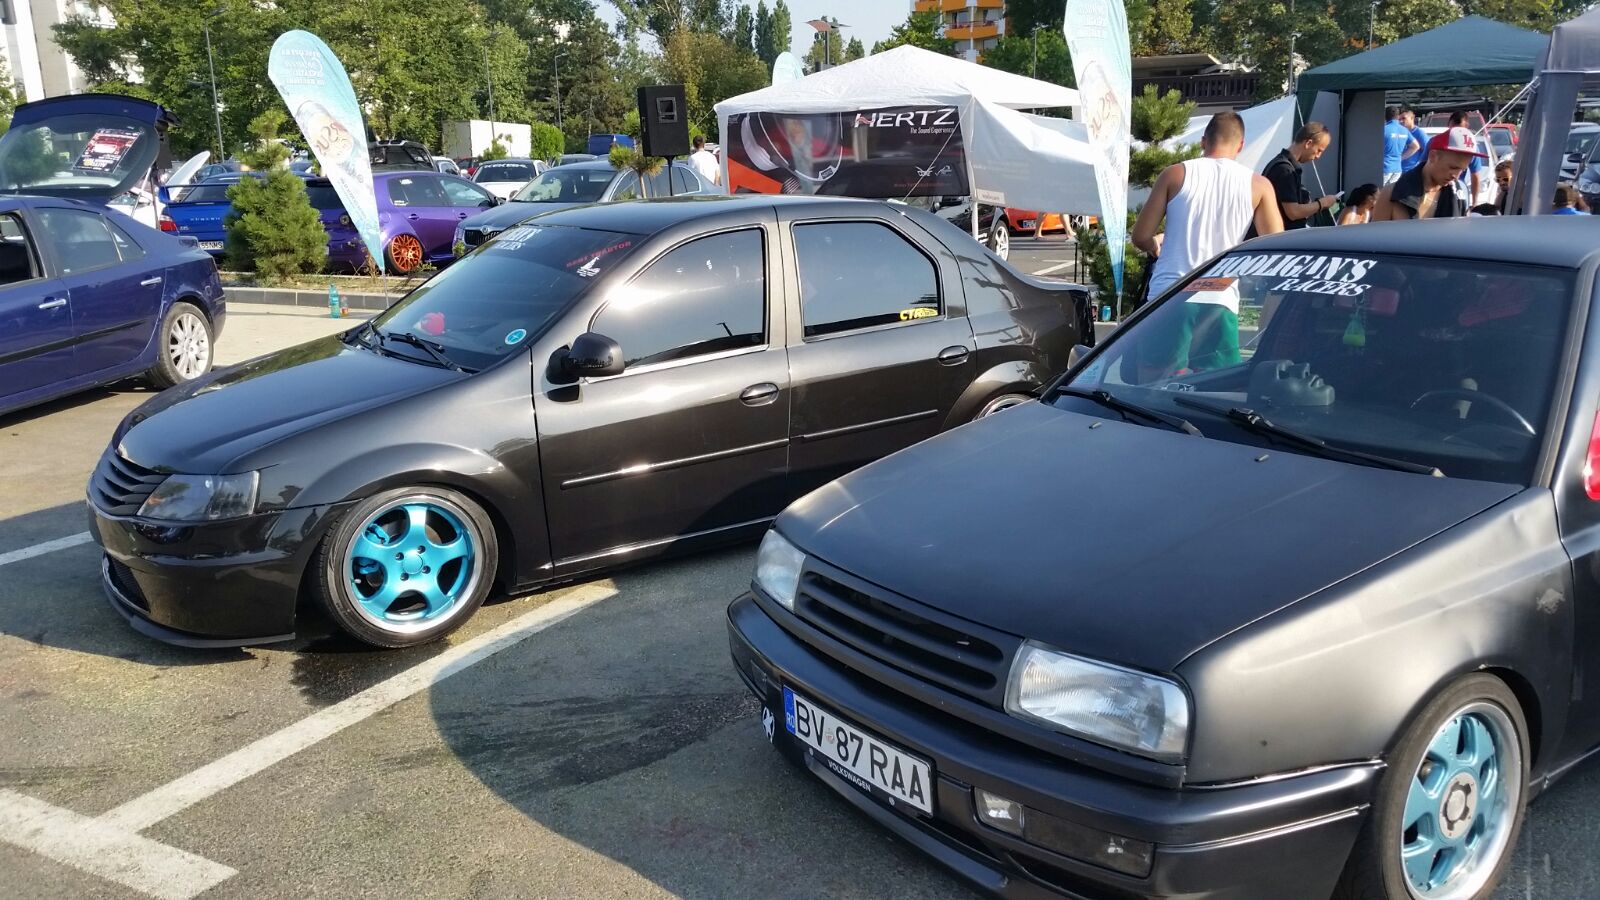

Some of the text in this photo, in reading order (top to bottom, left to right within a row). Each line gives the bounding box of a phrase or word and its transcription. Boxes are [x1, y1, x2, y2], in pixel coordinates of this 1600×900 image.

[854, 108, 956, 128] HERTZ
[918, 126, 931, 134] Sound
[1203, 254, 1377, 282] HOOLIGAN'S
[1270, 278, 1372, 296] RACERS
[786, 711, 795, 729] RO
[796, 700, 926, 805] BV 87 RAA
[827, 759, 872, 792] VOLKSWAGEN
